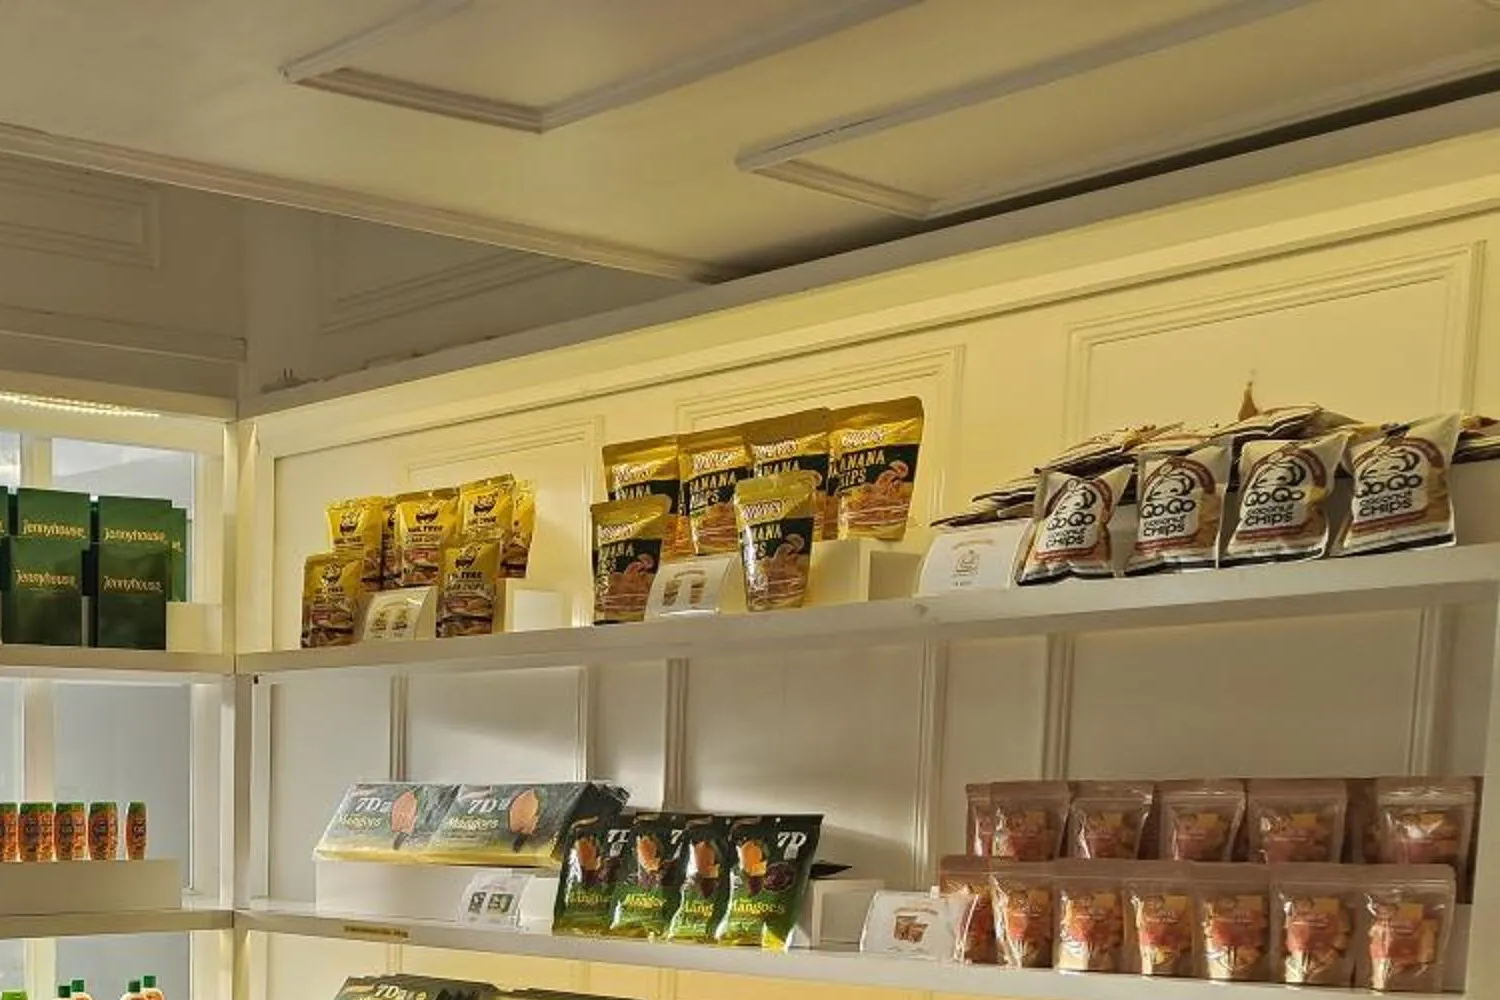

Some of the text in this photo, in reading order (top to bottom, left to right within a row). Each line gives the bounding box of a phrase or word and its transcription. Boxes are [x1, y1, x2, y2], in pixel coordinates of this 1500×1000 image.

[355, 798, 381, 812] 7D
[467, 799, 497, 814] 7D
[777, 831, 808, 849] 7D
[374, 984, 400, 1000] 7D
